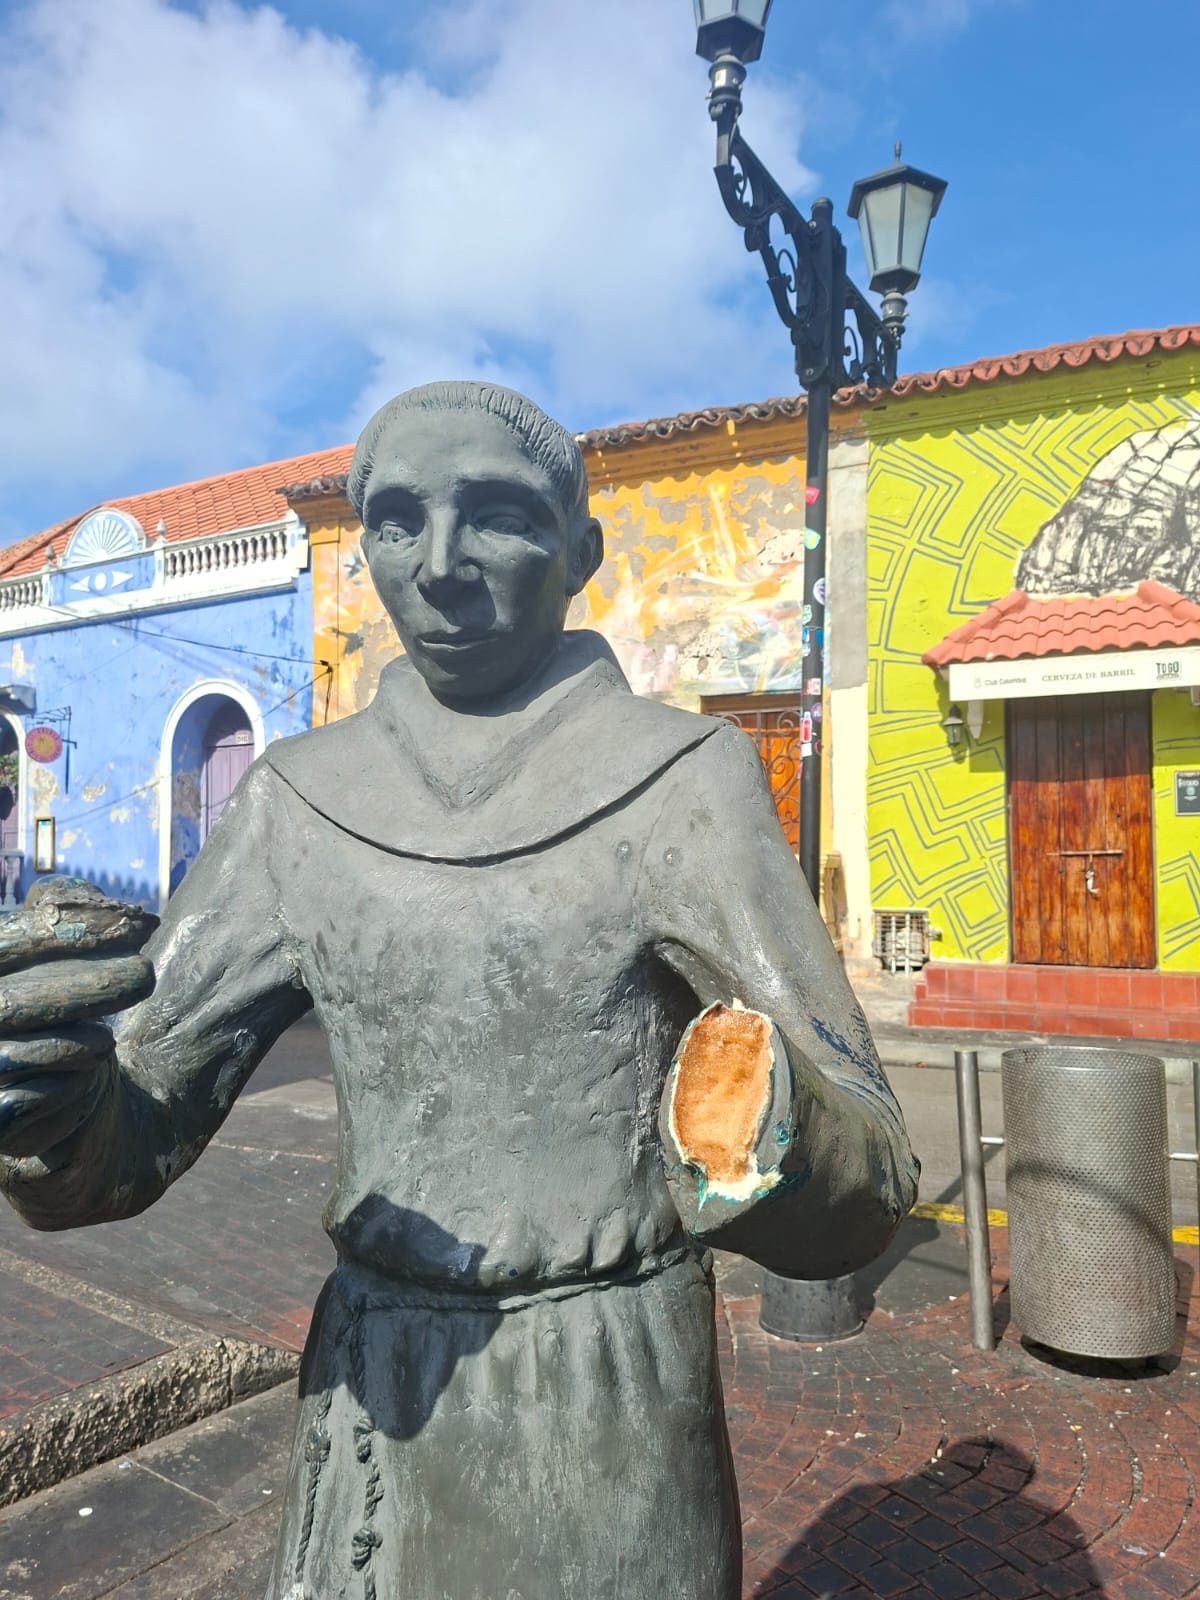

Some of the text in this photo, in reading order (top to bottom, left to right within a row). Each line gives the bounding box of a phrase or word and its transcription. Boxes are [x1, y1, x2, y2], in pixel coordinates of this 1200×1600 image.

[1041, 668, 1136, 682] CERVEZA DE BARRIL
